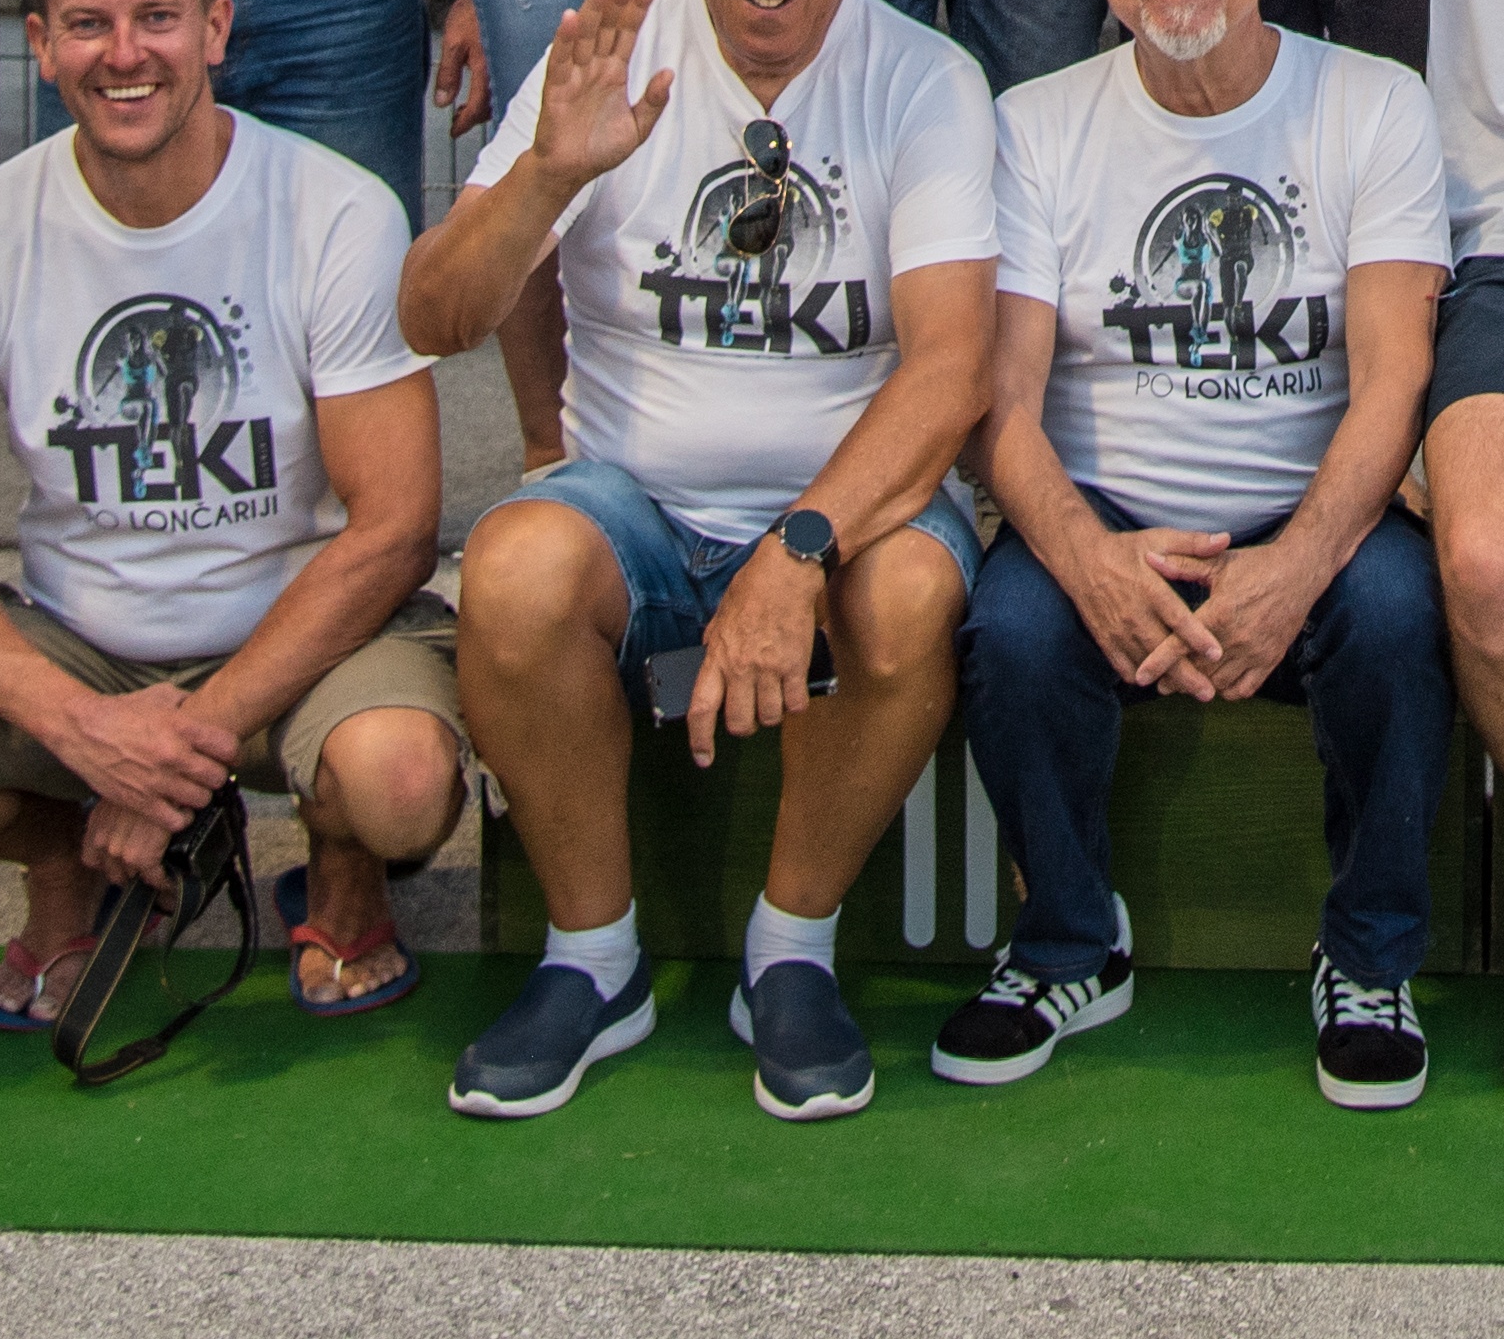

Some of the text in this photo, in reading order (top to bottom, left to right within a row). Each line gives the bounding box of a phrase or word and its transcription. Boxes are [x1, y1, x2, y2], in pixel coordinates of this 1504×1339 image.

[639, 271, 872, 354] TEKI
[1102, 294, 1329, 371] TEKI
[1135, 366, 1323, 401] PO LONČARIJI
[47, 417, 278, 504] TEKI
[129, 493, 279, 533] LONČARIJI
